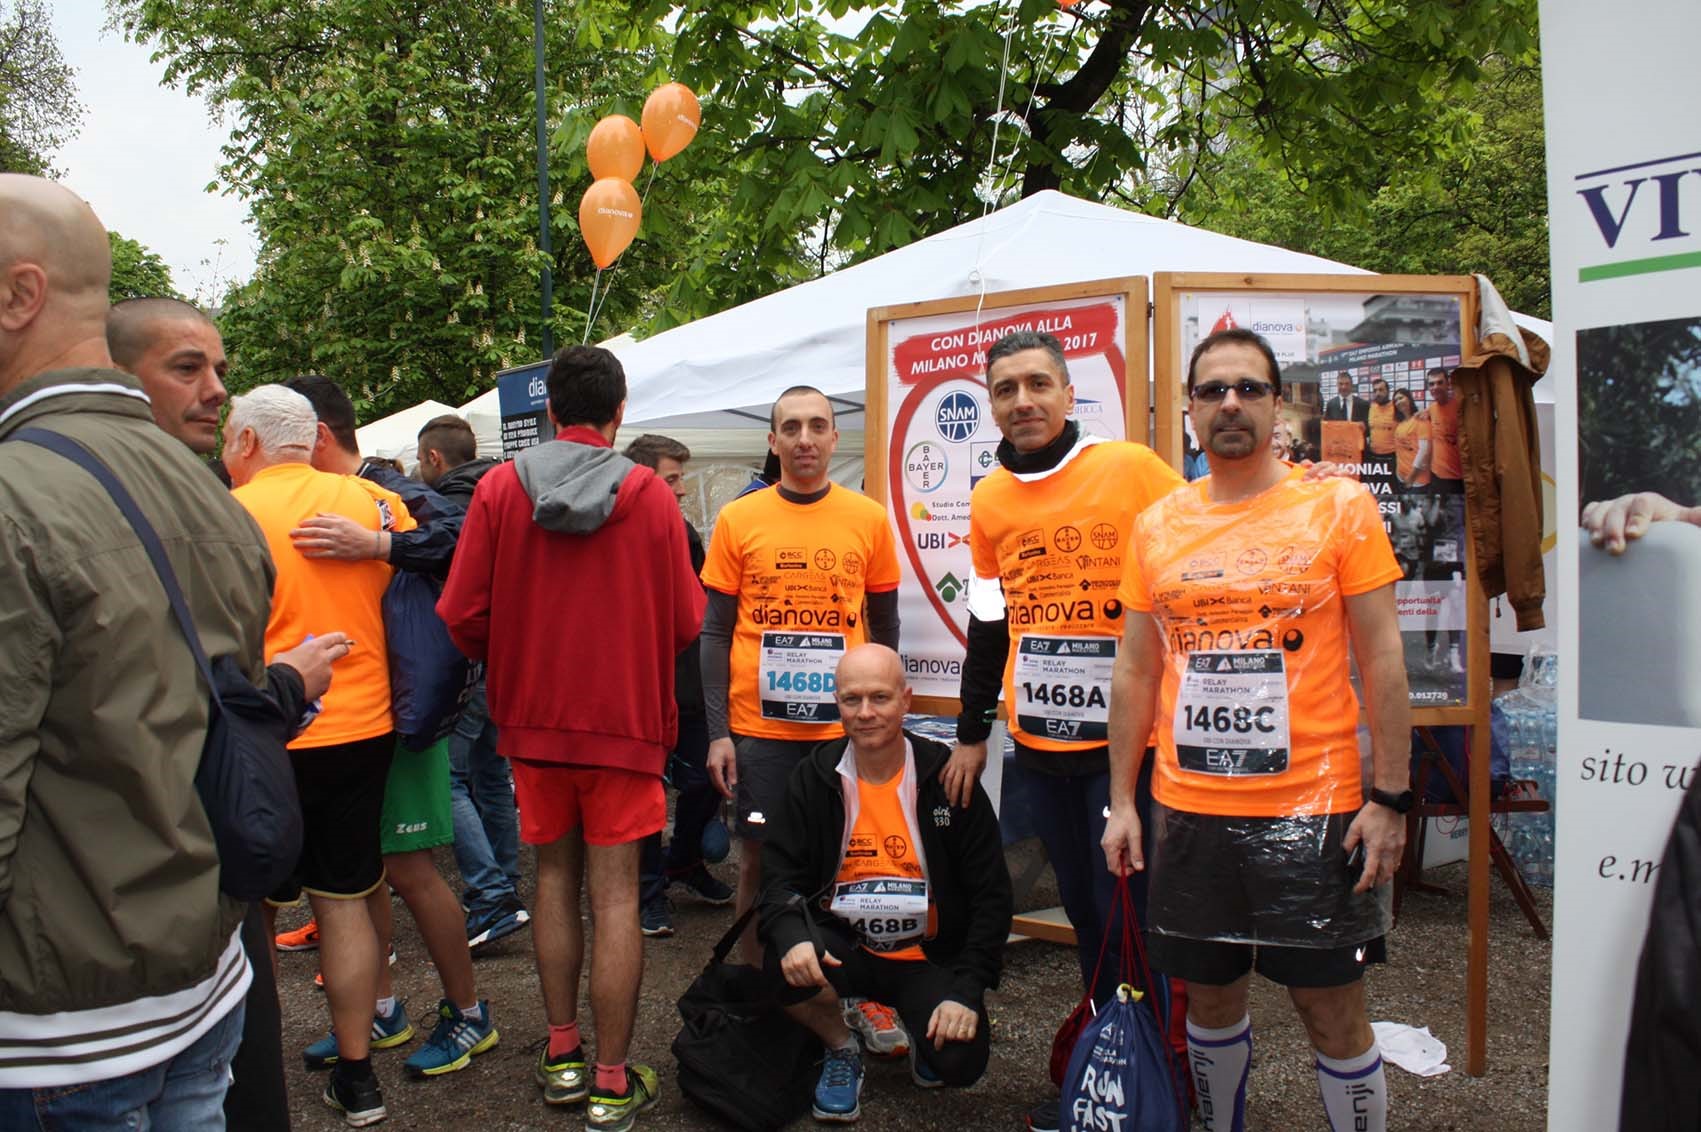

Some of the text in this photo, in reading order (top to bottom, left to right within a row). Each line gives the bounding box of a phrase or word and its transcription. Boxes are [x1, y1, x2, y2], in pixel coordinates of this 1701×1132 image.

[1576, 168, 1701, 249] VI
[931, 335, 967, 352] CON
[1036, 315, 1073, 334] ALLA
[1252, 320, 1293, 332] dianova
[911, 353, 968, 375] MILANO
[1064, 332, 1098, 351] 2017
[940, 405, 976, 421] SNAM
[908, 462, 945, 472] BAYER
[1379, 501, 1401, 514] SSI
[918, 532, 945, 550] UBI
[752, 604, 840, 628] dianova
[775, 636, 794, 646] EA7
[1030, 640, 1050, 651] EA7
[903, 654, 960, 675] ianova
[1042, 667, 1086, 675] MARATHON
[767, 670, 836, 692] 1468D
[1203, 677, 1228, 686] RELAY
[1022, 681, 1106, 709] 1468A
[1203, 686, 1251, 695] MARATHON
[786, 703, 818, 717] EA7
[1184, 704, 1276, 733] 1468C
[1046, 719, 1081, 736] EA7
[1206, 749, 1248, 767] EA7
[1580, 747, 1648, 786] sito
[395, 822, 427, 834] Zeus
[851, 918, 918, 935] 468B
[1080, 1063, 1126, 1107] RUN
[1072, 1097, 1129, 1132] FAST
